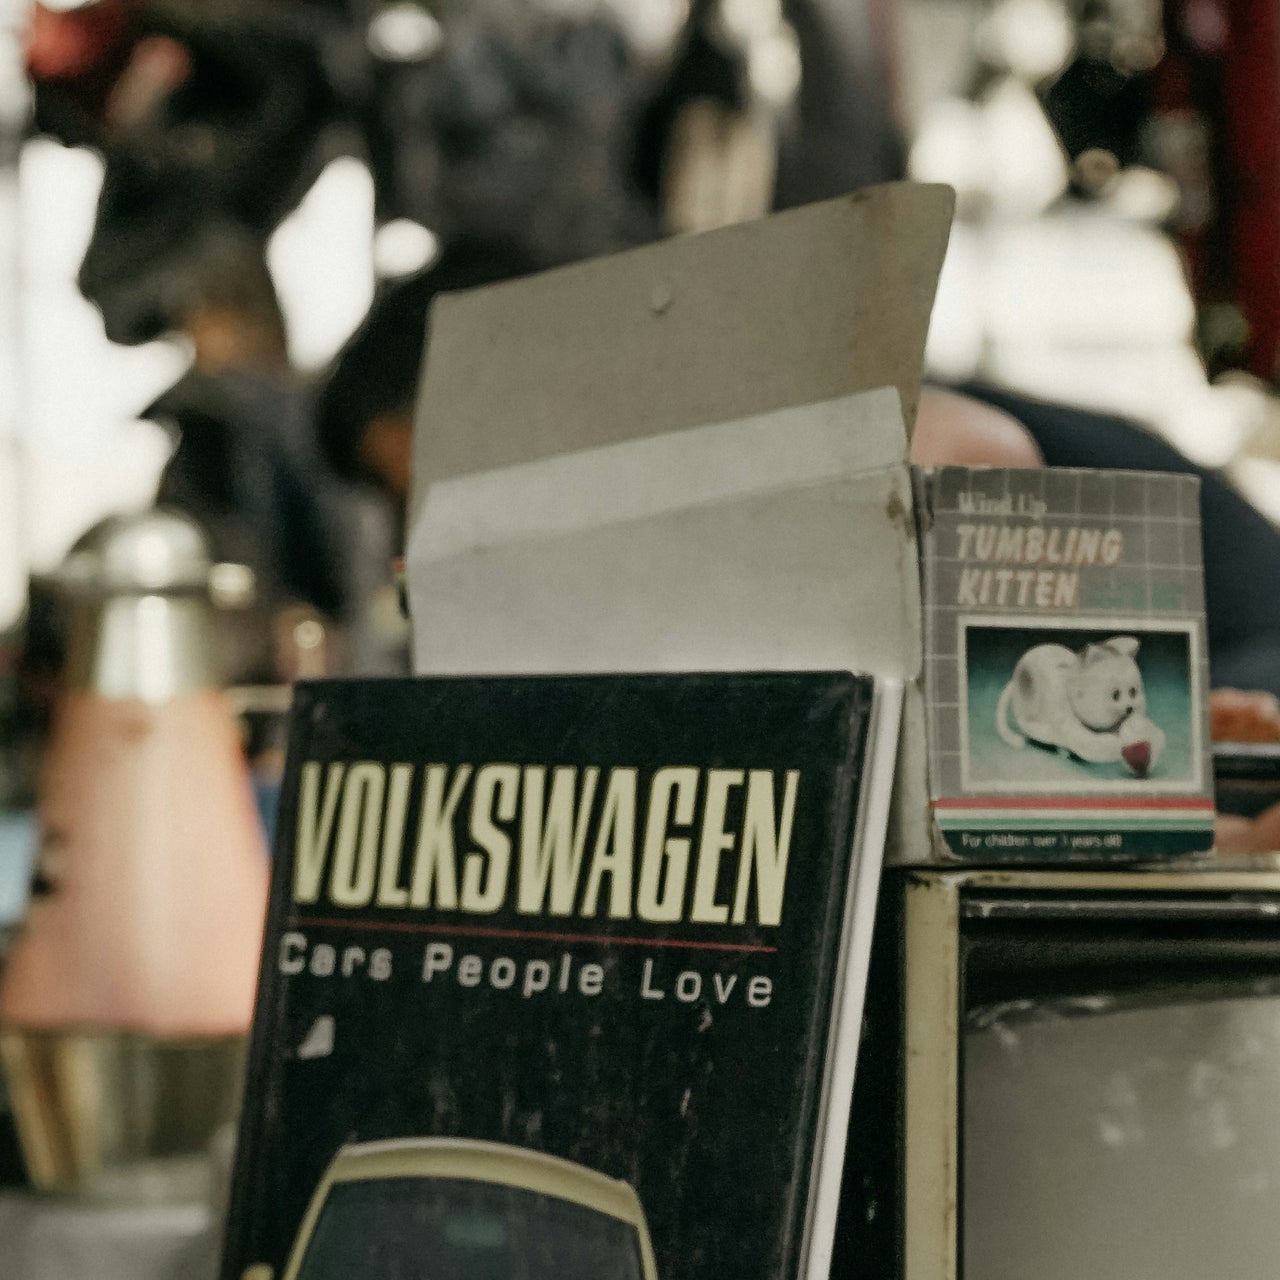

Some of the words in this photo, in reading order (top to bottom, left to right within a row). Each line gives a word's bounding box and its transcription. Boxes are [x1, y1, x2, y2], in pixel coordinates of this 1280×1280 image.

[955, 524, 1124, 565] TUMBLING
[956, 569, 1081, 608] KITTEN
[293, 761, 801, 927] VOLKSWAGEN
[278, 931, 394, 982] Cars
[422, 942, 605, 999] People
[641, 957, 774, 1008] Love
